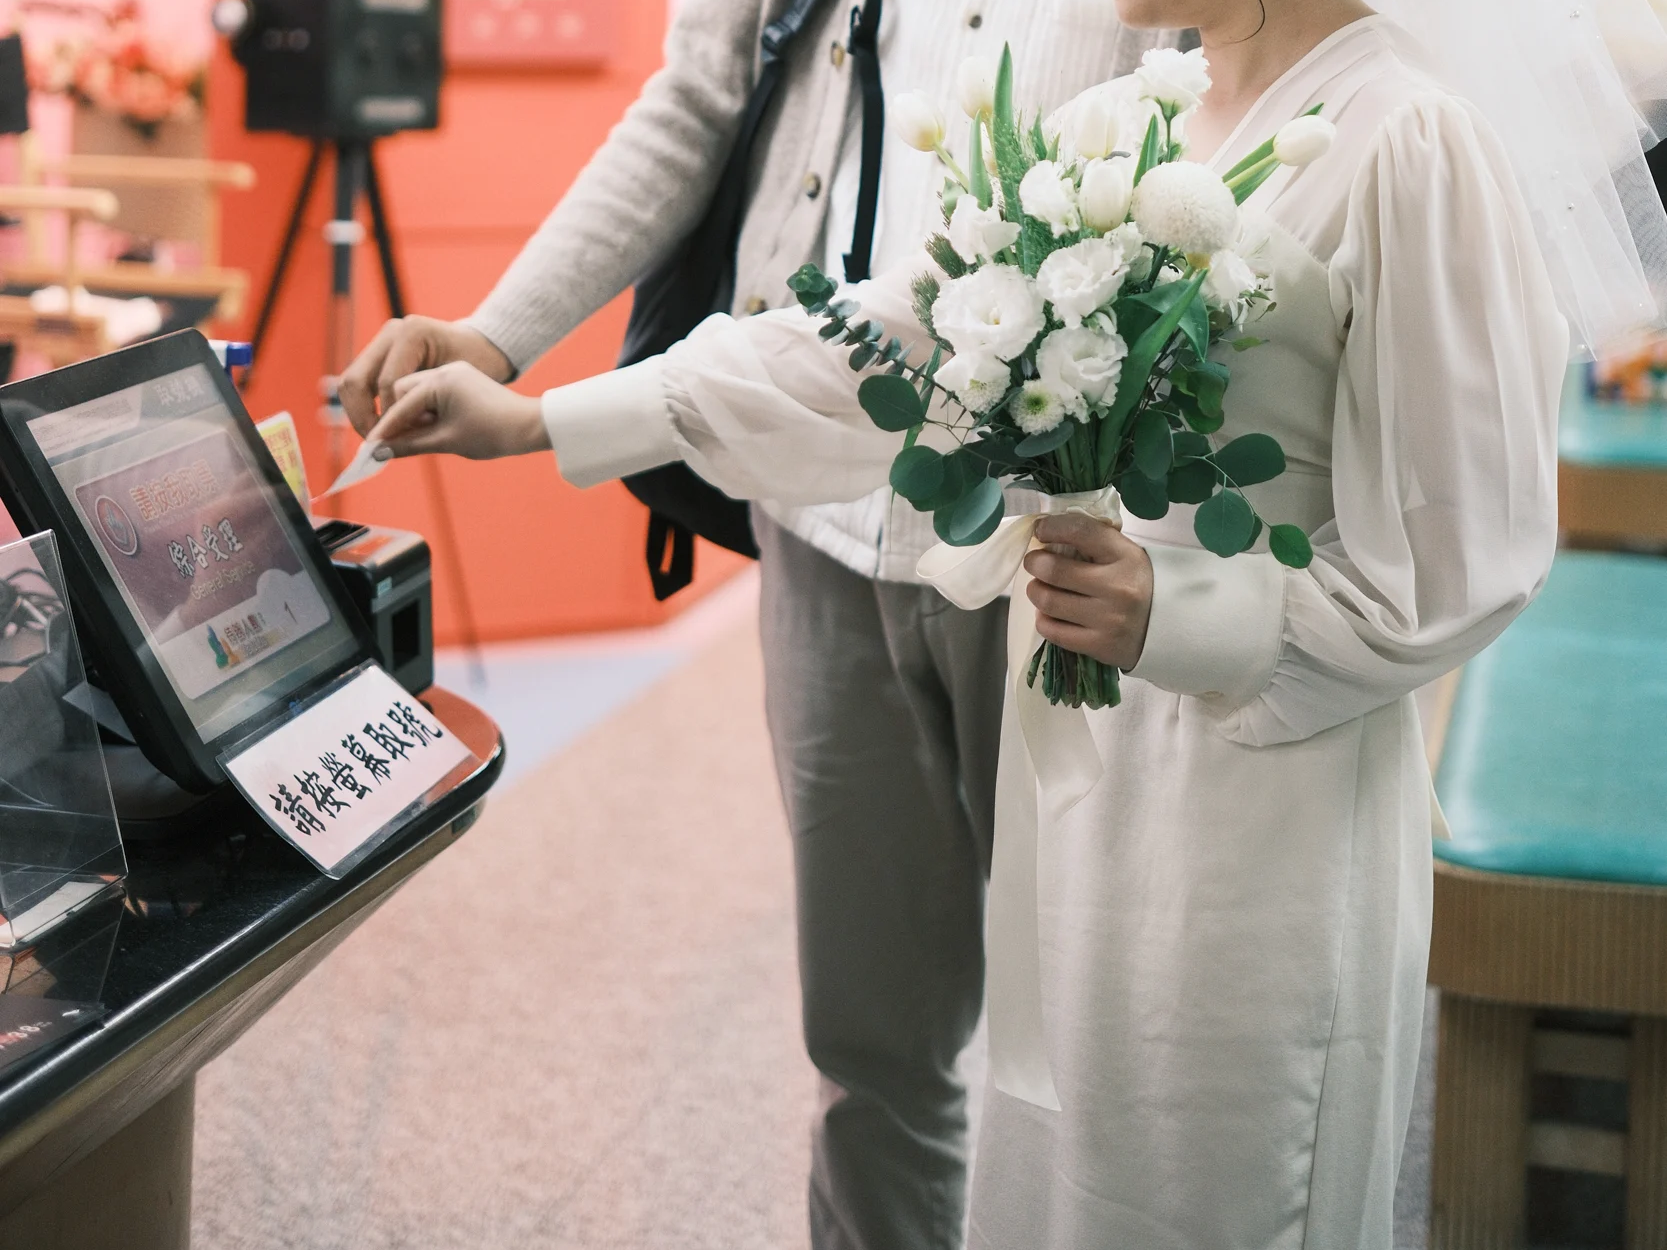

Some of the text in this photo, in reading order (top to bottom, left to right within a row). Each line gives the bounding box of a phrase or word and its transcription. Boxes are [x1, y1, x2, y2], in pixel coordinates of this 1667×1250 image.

[129, 458, 219, 522] 請按我取票
[167, 516, 243, 579] 綜合受理
[189, 570, 223, 600] General
[268, 701, 443, 836] 請按螢幕取號
